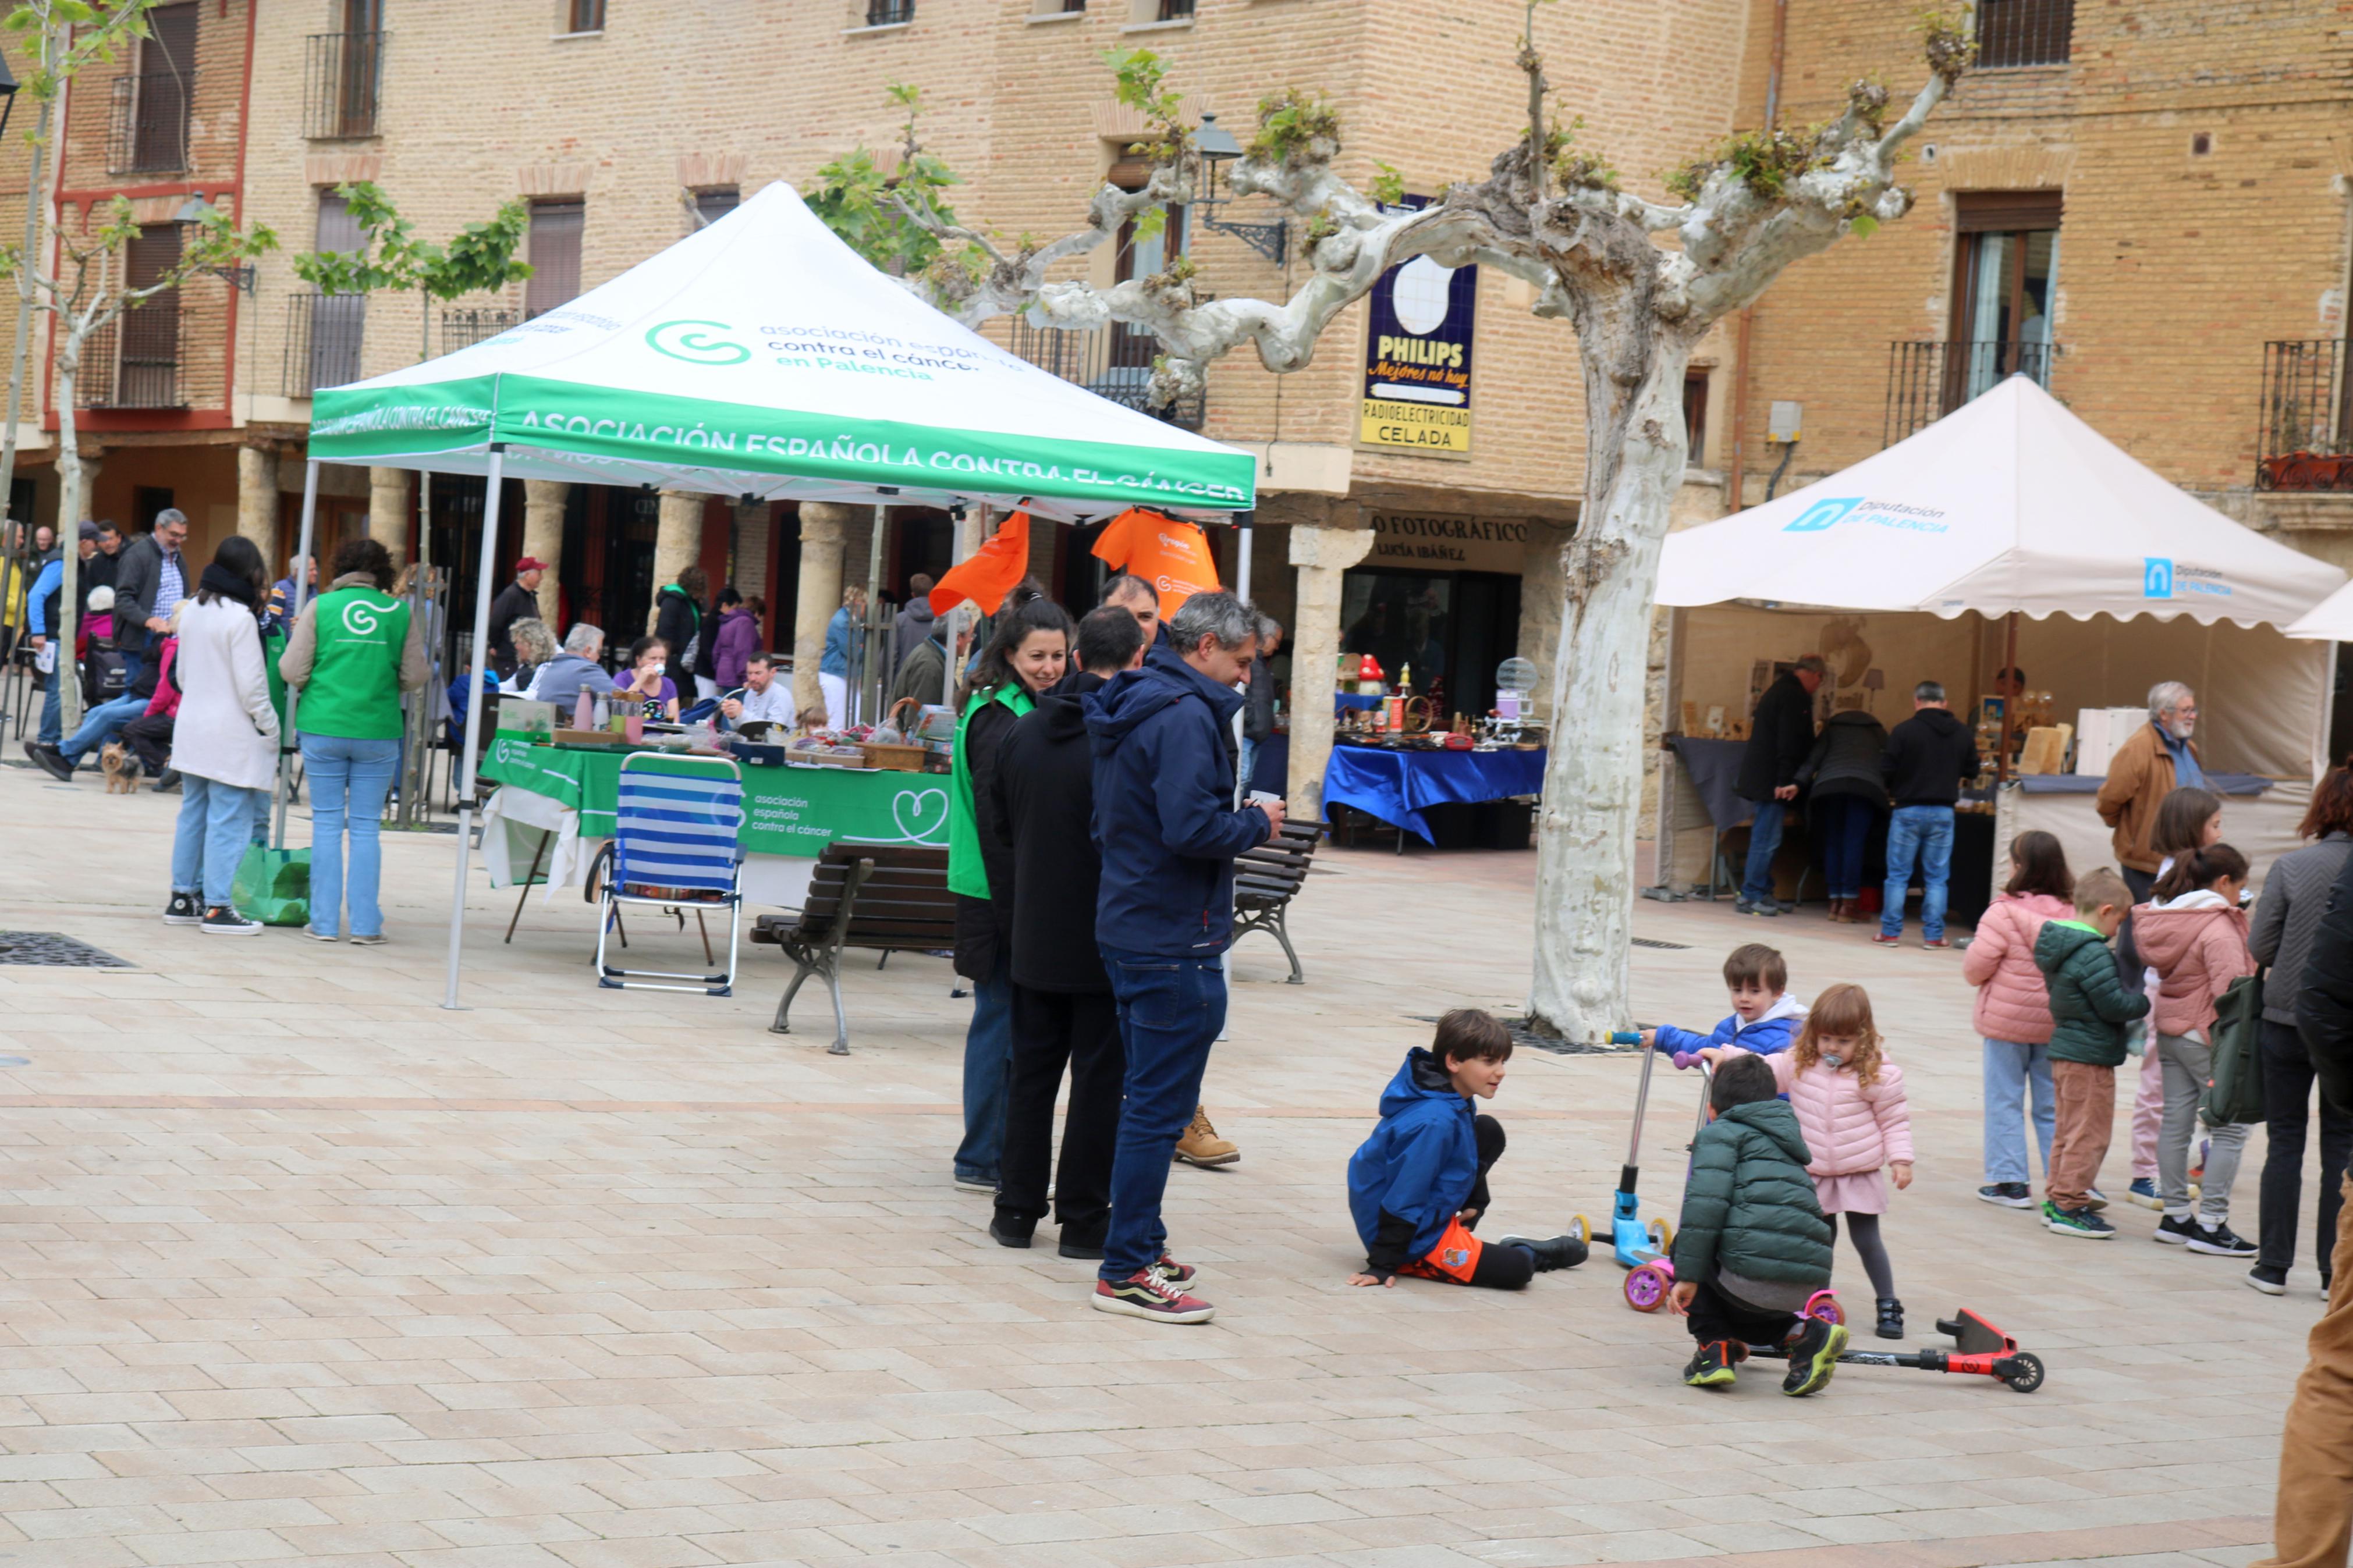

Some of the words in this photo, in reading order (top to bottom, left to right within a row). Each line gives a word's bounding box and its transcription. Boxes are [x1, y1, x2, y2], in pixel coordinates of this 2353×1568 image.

[759, 325, 902, 349] asociación
[768, 340, 856, 357] contra
[863, 348, 885, 360] el
[1377, 335, 1463, 368] PHILIPS
[776, 356, 810, 368] en
[815, 356, 935, 382] Palencia
[1368, 361, 1426, 382] Mejores
[1445, 368, 1470, 389] hay
[1364, 402, 1470, 427] RADIOELECTRICIDAD
[1379, 425, 1451, 447] CELADA
[747, 433, 927, 469] ESPAÑOLA
[1857, 501, 1946, 518] Diputación
[1390, 516, 1528, 543] FOTOGRÁFICO
[1865, 513, 1950, 534] PALENCIA
[1377, 542, 1415, 557] LUCÍA
[754, 795, 808, 808] asociación
[753, 808, 800, 820] española
[752, 822, 785, 833] contra
[786, 823, 796, 833] el
[797, 825, 833, 837] cáncer
